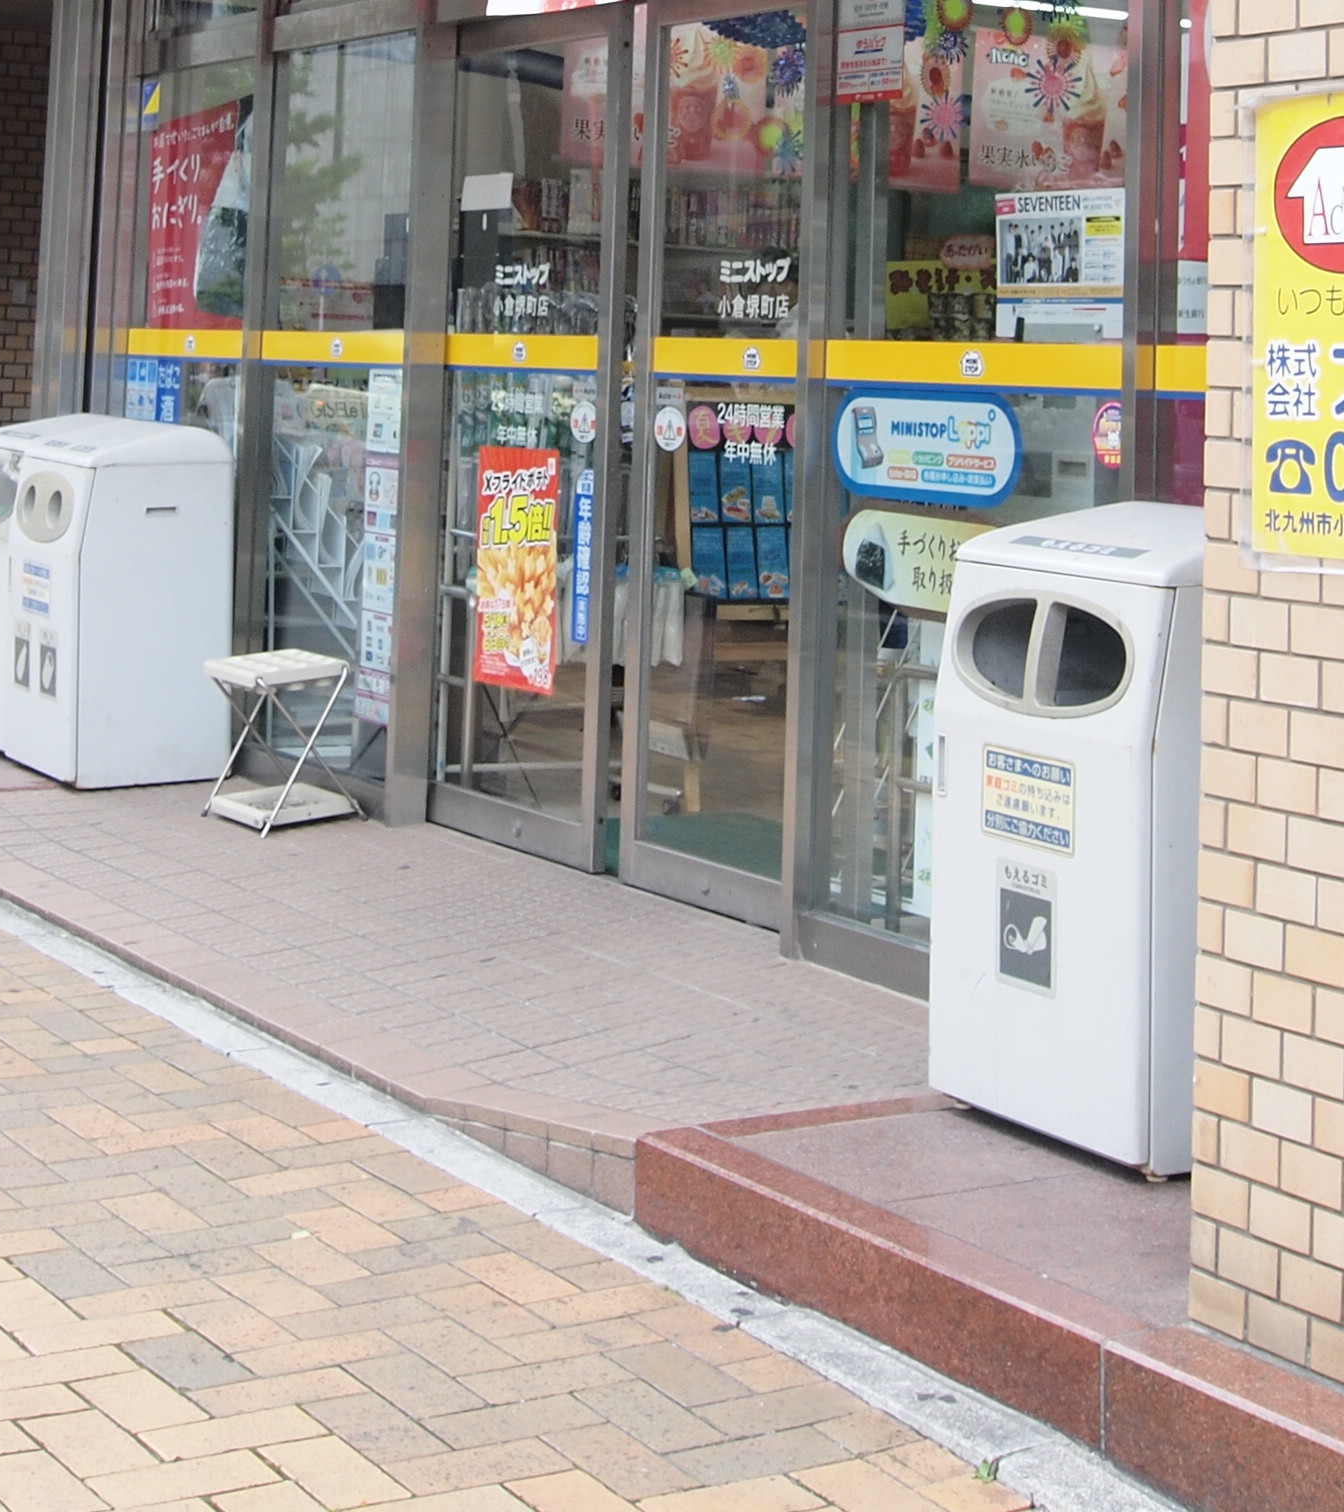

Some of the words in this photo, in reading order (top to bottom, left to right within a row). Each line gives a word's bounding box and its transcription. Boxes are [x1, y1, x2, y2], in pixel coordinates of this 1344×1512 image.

[1017, 195, 1081, 213] SEVENTEEN
[494, 262, 551, 286] ミニストップ
[719, 257, 791, 283] ミニストップ
[717, 294, 790, 319] 小倉堺町店
[1266, 342, 1317, 380] 株式
[158, 364, 181, 389] たばこ
[160, 395, 175, 422] 酒
[1266, 382, 1317, 419] 会社
[717, 402, 786, 430] 24時間営業
[891, 420, 947, 438] MINISTOP
[724, 439, 777, 467] 年中無休
[988, 752, 1070, 784] お客さまへのお願い
[986, 774, 1071, 806] 家庭ゴミの持ち込みは
[986, 811, 1069, 846] 分別にご協力ください
[1005, 865, 1048, 889] もえるゴミ
